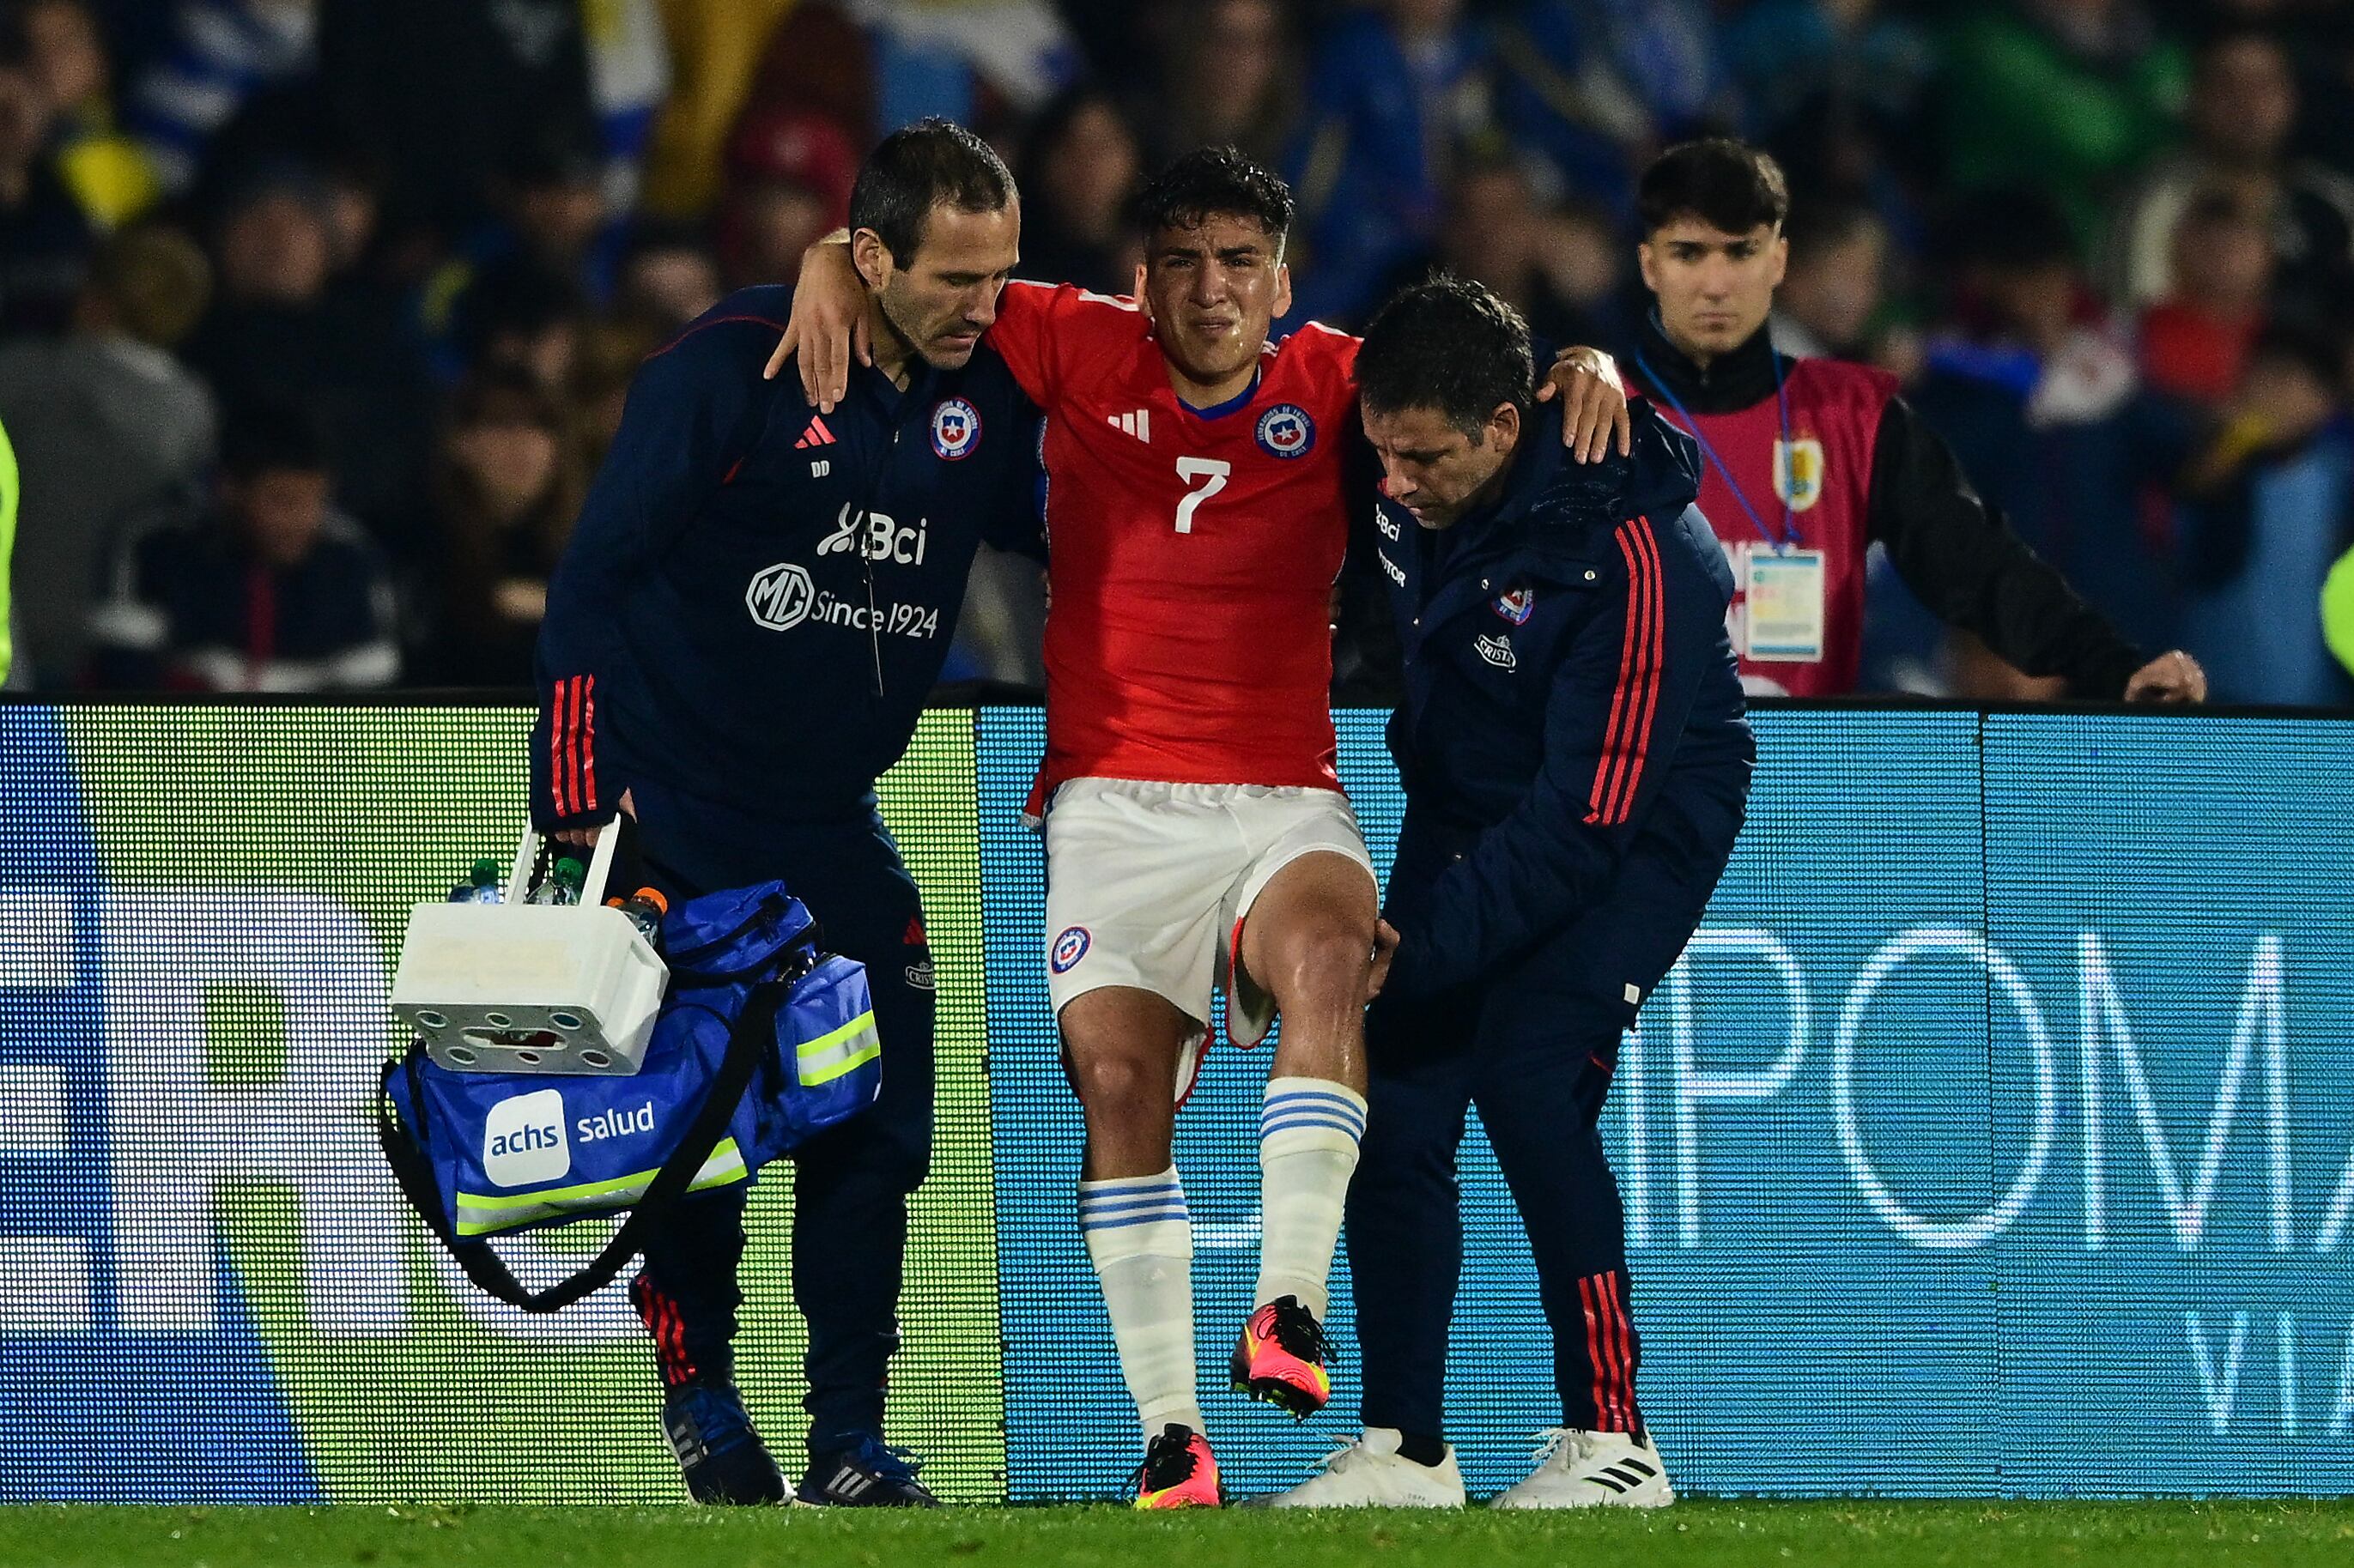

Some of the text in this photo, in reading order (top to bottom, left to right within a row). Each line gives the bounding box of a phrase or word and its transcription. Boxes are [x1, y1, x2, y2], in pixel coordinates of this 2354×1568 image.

[810, 460, 830, 478] DD
[1174, 456, 1231, 534] 7
[861, 512, 926, 566] Bci
[1380, 514, 1401, 542] Bci
[751, 568, 810, 624] MG
[811, 590, 939, 639] Since 1924
[492, 1101, 655, 1157] achs salud
